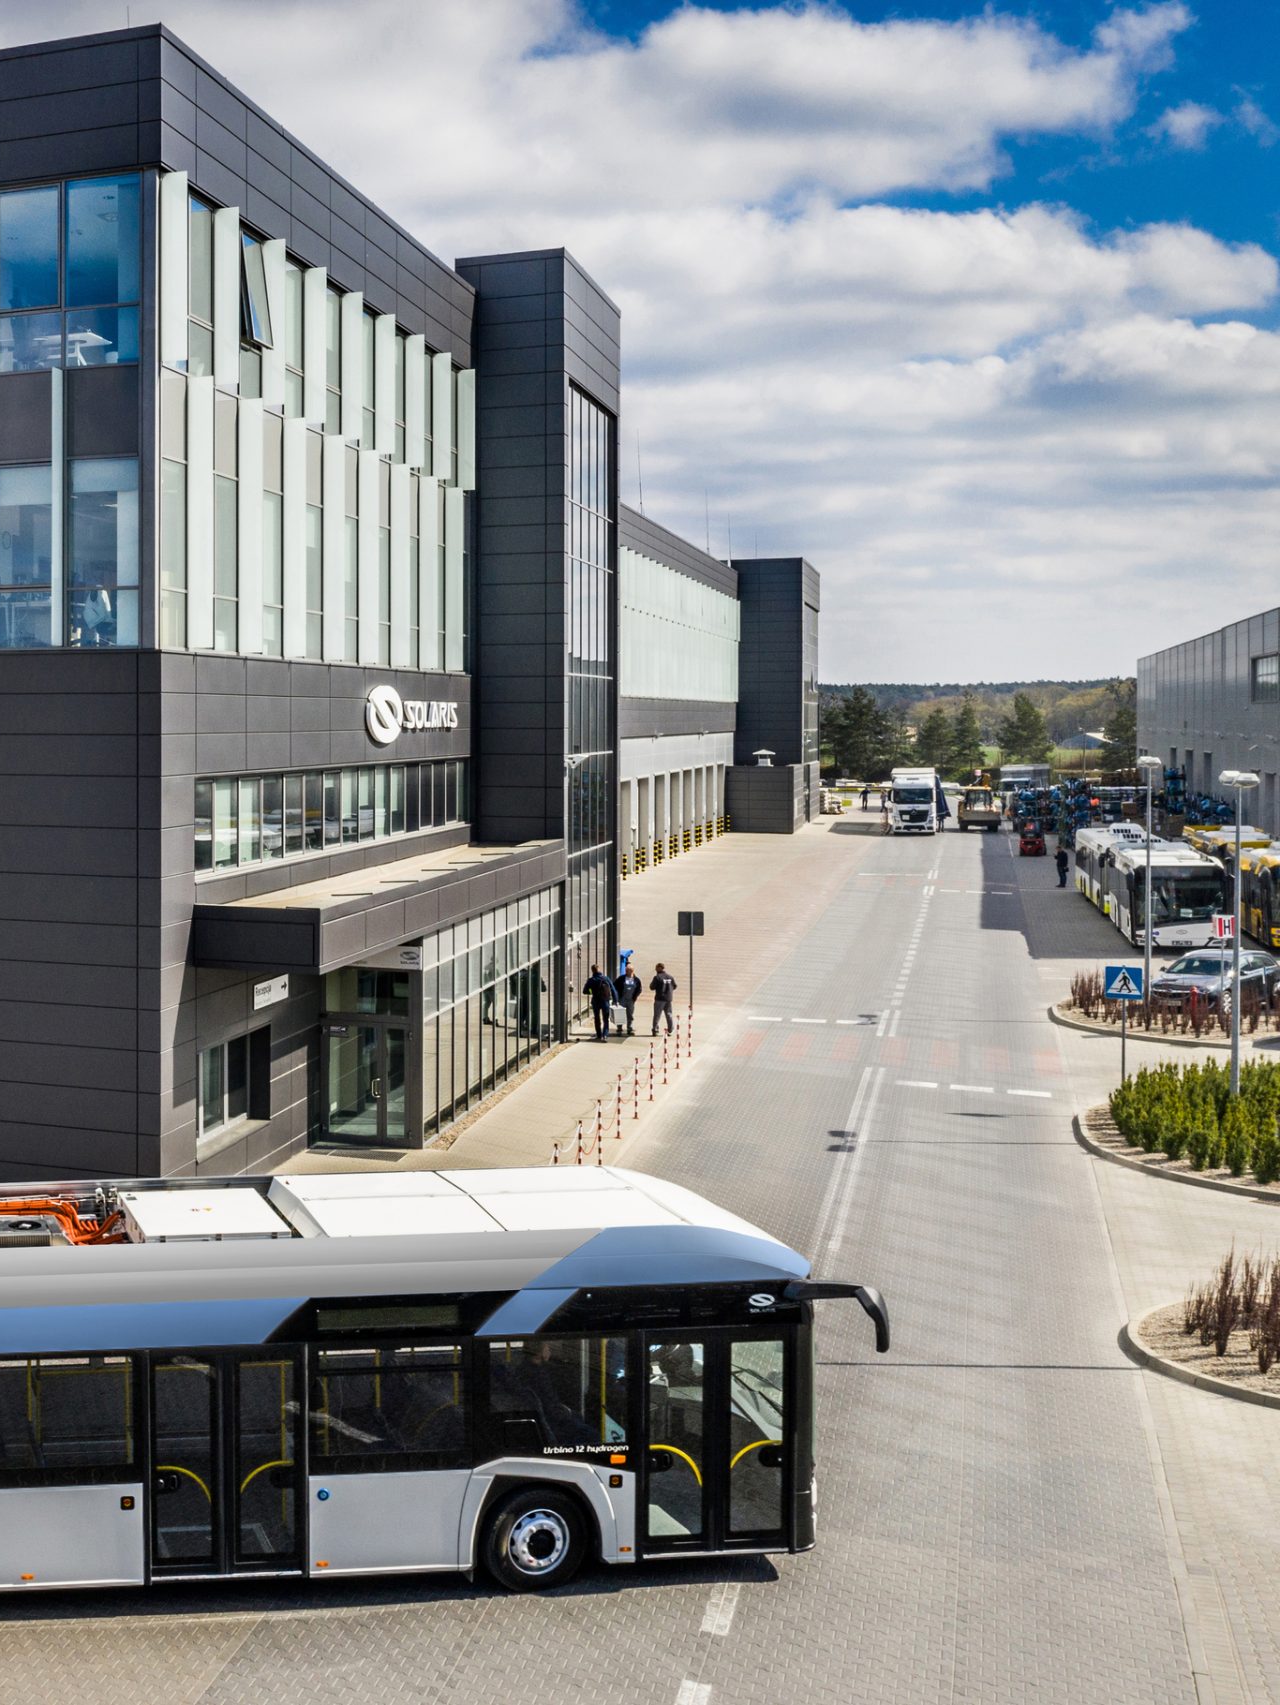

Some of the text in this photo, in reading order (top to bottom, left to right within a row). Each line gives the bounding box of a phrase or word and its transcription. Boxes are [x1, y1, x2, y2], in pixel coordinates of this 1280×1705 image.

[402, 700, 458, 729] SOLARIS
[1223, 919, 1231, 936] H
[543, 1445, 629, 1454] Urbino 12 hydrogen
